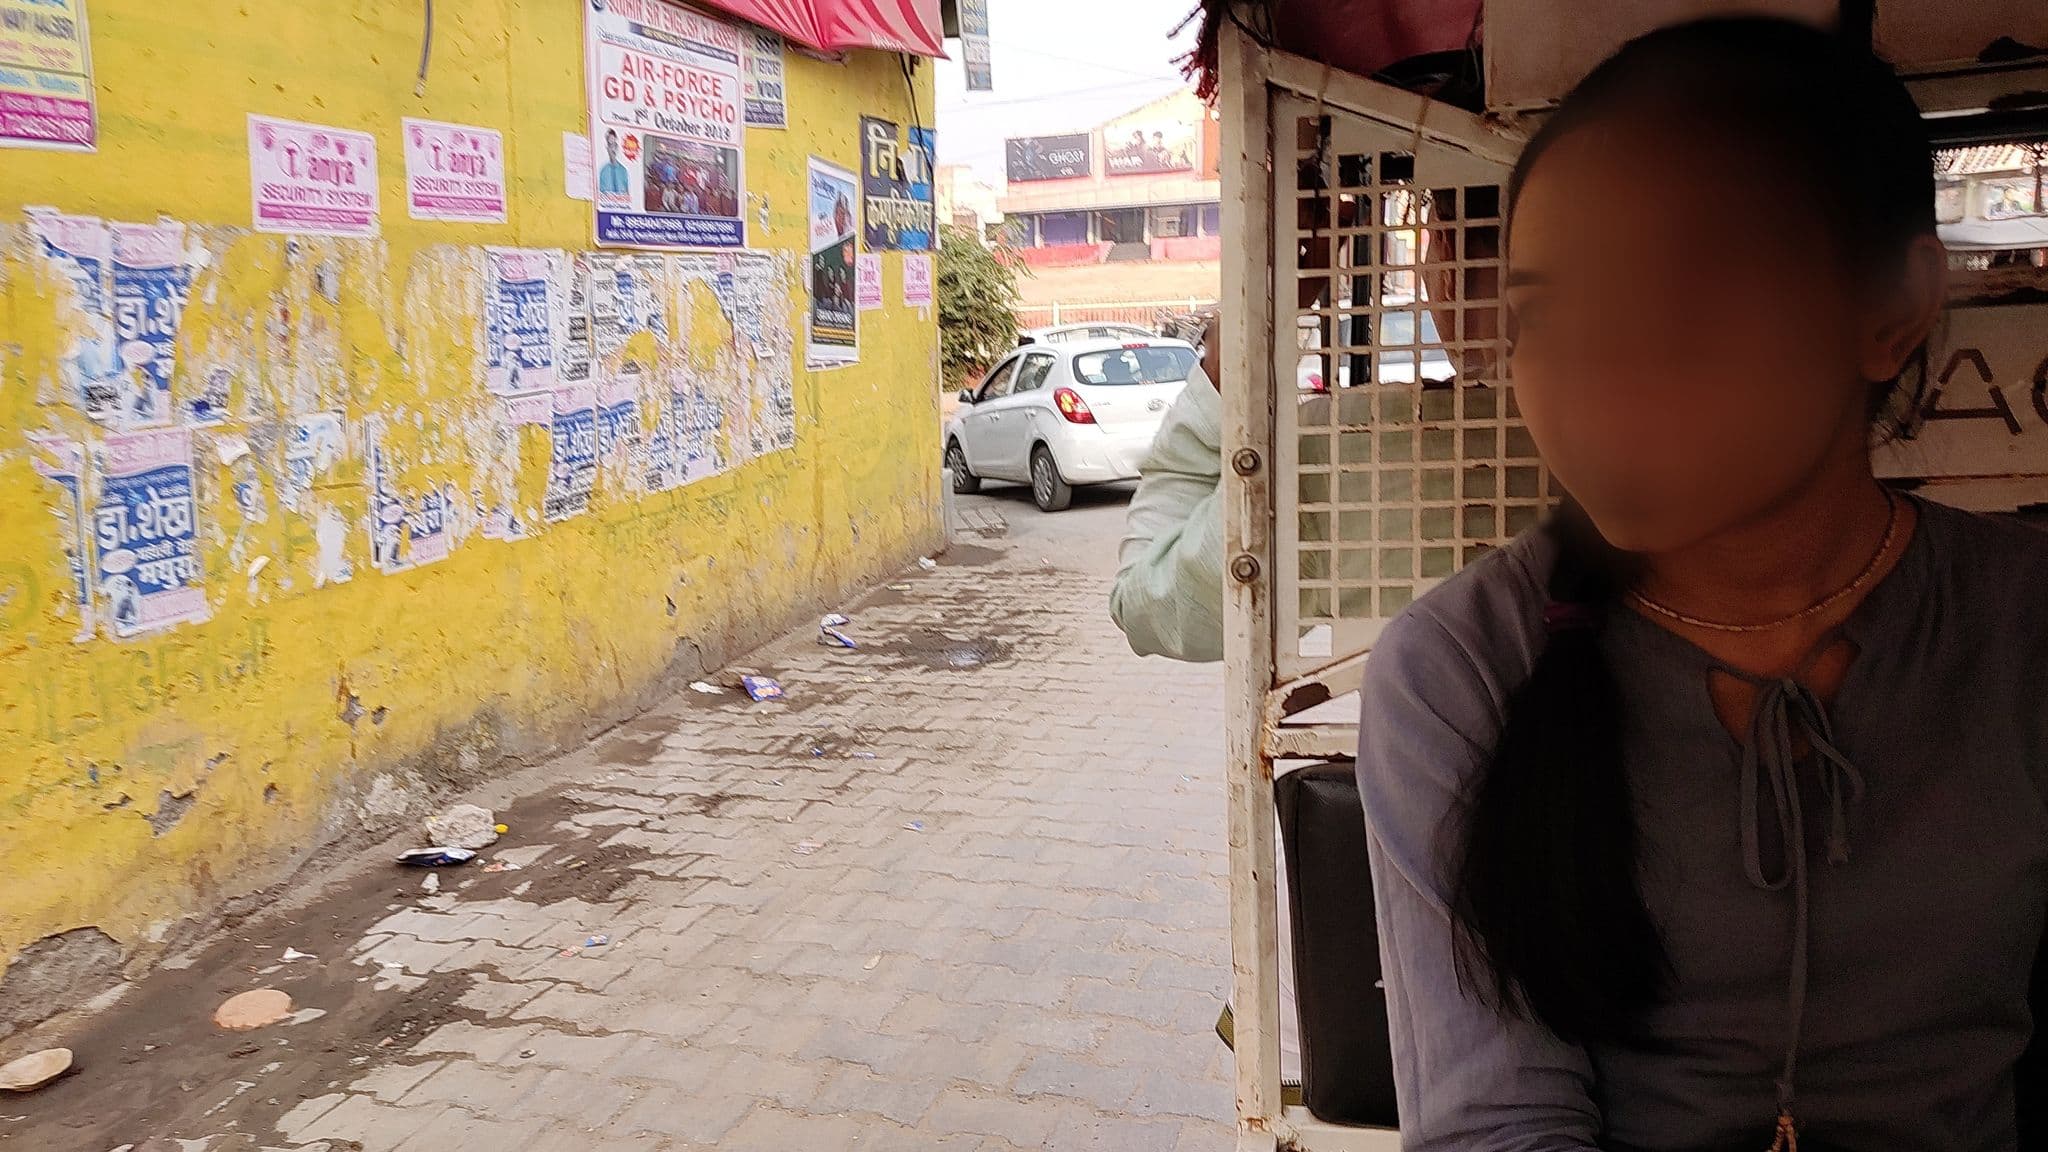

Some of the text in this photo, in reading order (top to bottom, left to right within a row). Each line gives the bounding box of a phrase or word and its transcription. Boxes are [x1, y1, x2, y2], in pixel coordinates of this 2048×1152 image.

[622, 53, 722, 98] AIR-FORCE
[604, 76, 636, 102] GD
[644, 85, 657, 108] &
[664, 89, 736, 124] PSYCHO
